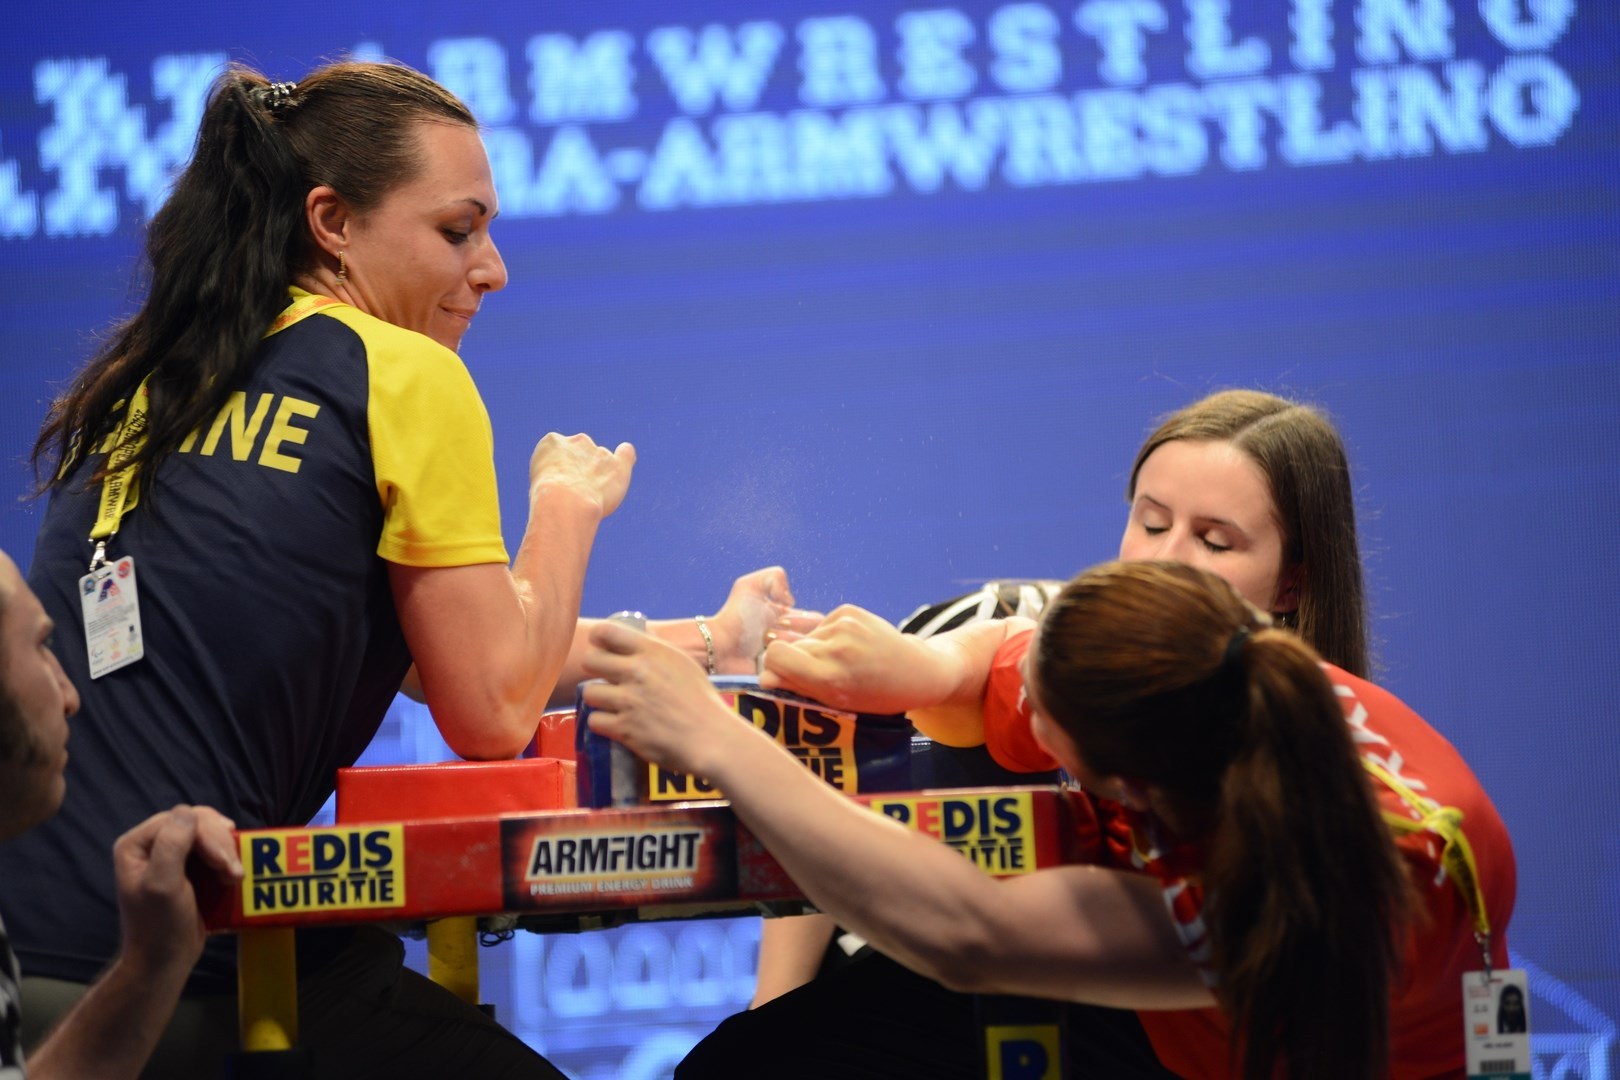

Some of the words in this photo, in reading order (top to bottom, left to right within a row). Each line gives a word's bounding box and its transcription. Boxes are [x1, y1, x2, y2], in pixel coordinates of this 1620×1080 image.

[251, 831, 394, 876] REDIS
[531, 832, 701, 877] ARMFIGHT
[253, 877, 395, 911] NUTRITIE
[530, 879, 592, 896] PREMIUM
[597, 878, 648, 893] ENERGY
[652, 875, 694, 889] DRINK
